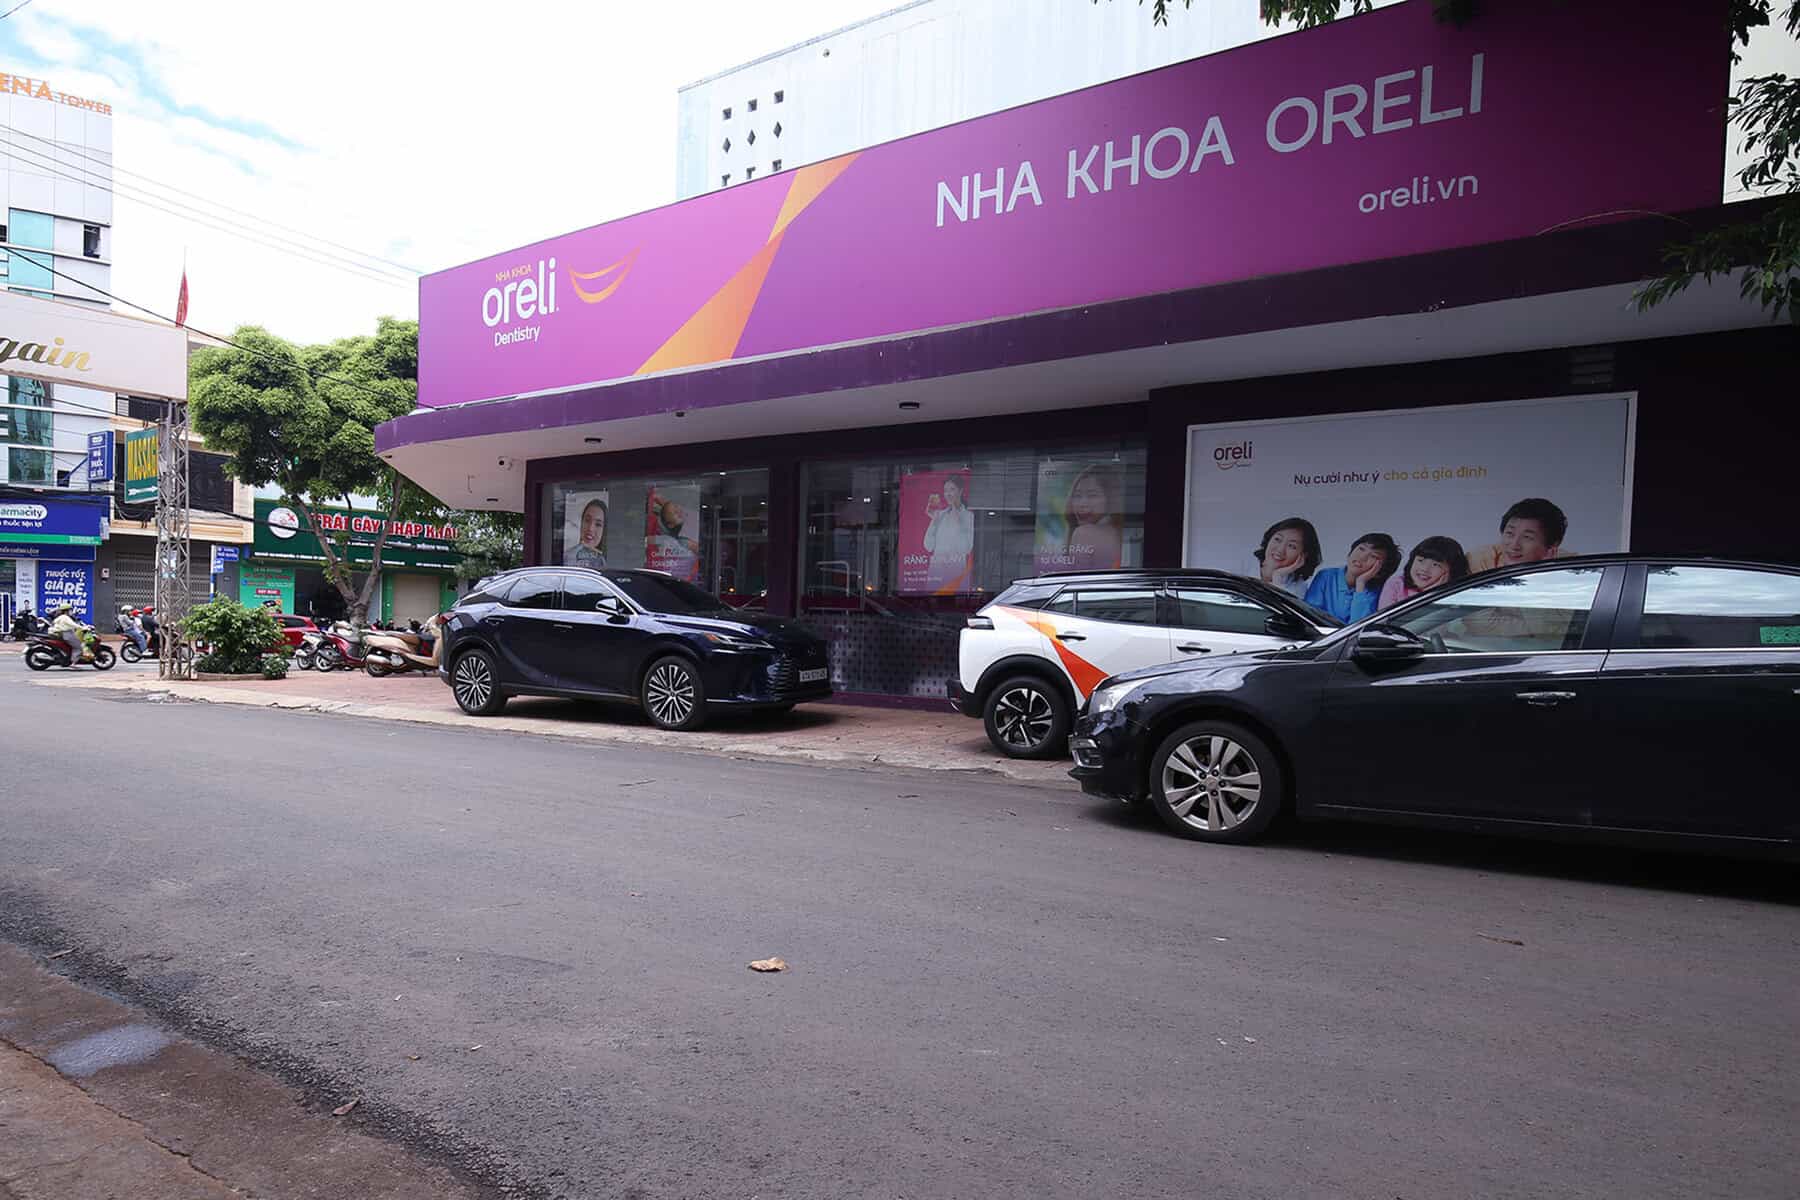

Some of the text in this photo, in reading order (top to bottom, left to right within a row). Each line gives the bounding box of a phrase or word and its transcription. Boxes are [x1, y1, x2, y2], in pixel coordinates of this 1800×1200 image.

[57, 91, 112, 116] TOWER
[936, 53, 1484, 227] NHA KHOA ORELI
[1358, 175, 1479, 213] oreli.vn
[495, 264, 532, 283] NHA KHOA
[482, 257, 556, 327] oreli
[494, 325, 541, 347] Dentistry
[1214, 441, 1253, 461] oreli
[1294, 464, 1487, 486] Nụ cười như ý cho cả gia đình
[352, 515, 380, 533] CÂY
[44, 578, 63, 590] GIÁ
[46, 568, 69, 578] THUỐC
